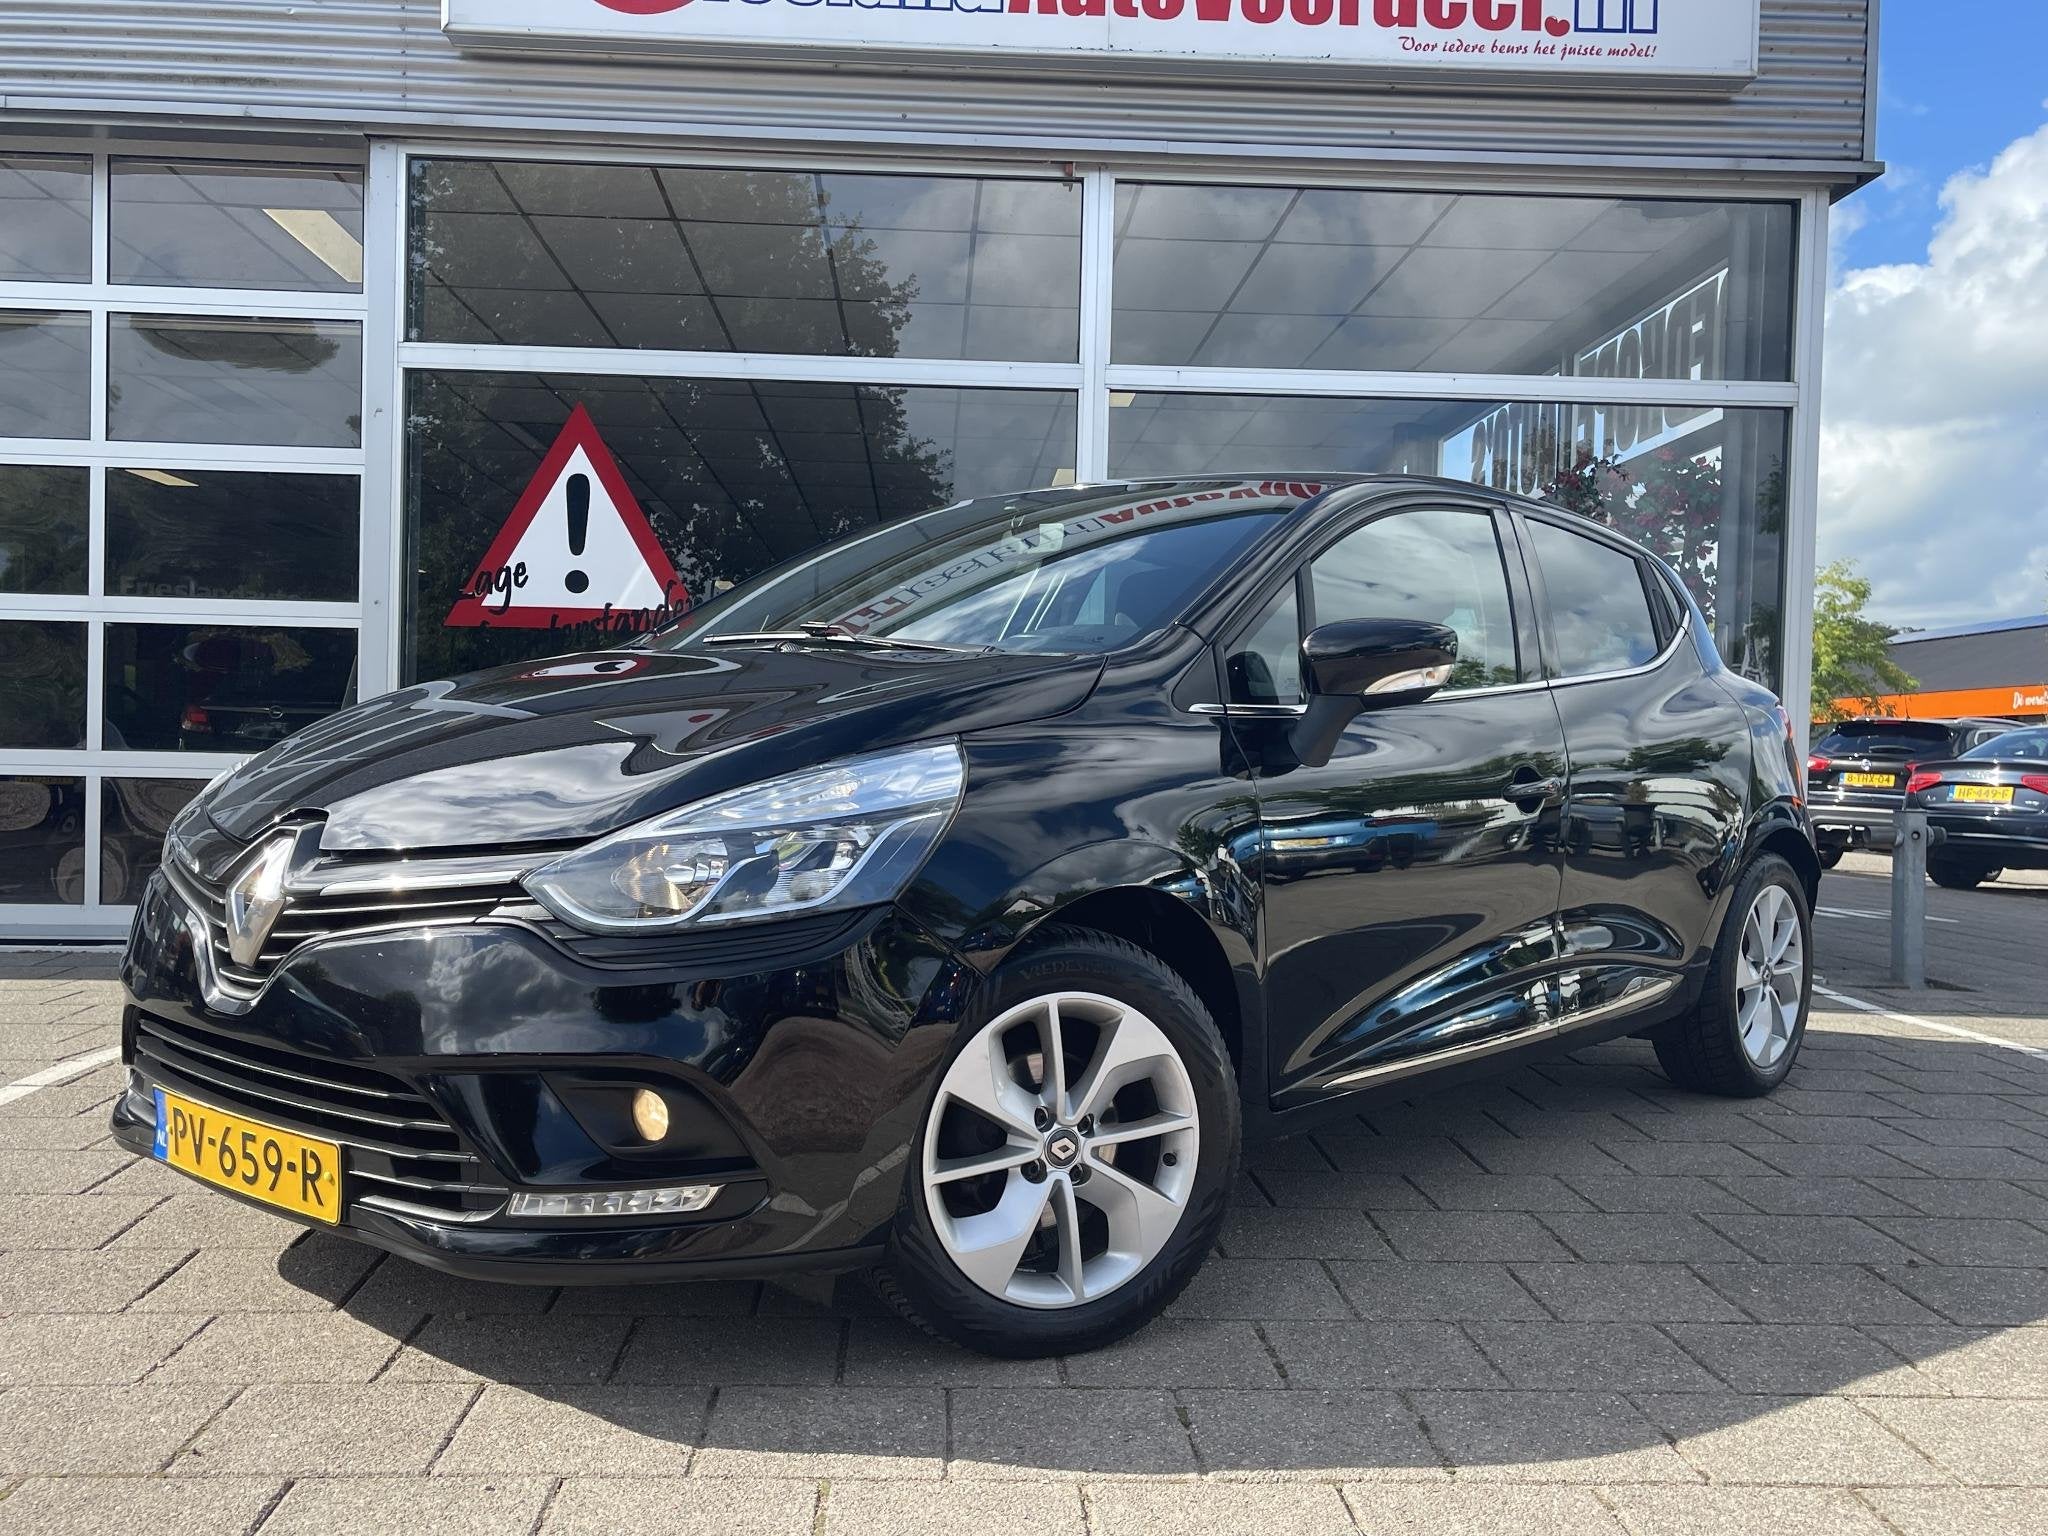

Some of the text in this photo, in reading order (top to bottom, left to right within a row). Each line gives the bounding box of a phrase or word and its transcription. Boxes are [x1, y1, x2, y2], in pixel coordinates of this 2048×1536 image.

[1398, 36, 1658, 61] Voor iedere beurs het juiste model!
[172, 1106, 324, 1207] PV-659-R
